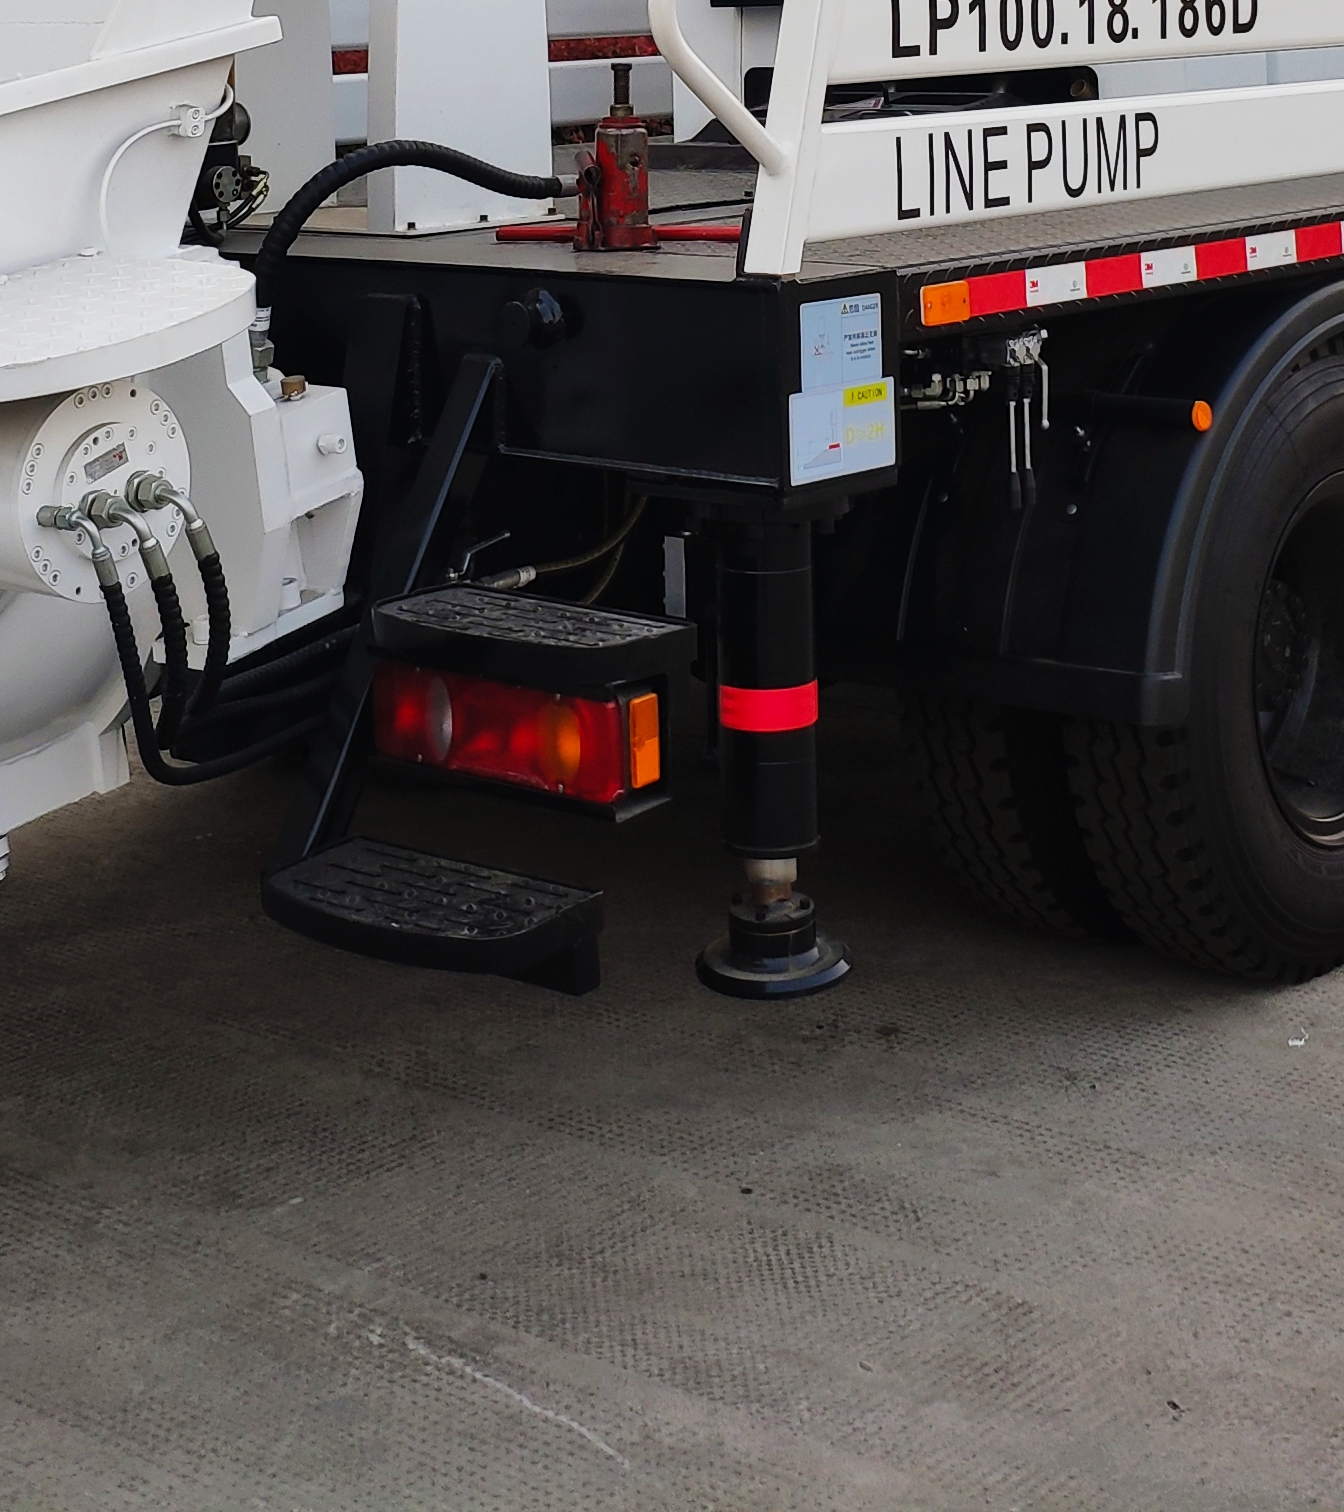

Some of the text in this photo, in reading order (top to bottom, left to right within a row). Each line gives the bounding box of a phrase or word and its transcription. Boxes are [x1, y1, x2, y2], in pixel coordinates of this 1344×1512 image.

[895, 111, 1159, 221] LINE PUMP
[857, 388, 883, 400] CAUTION
